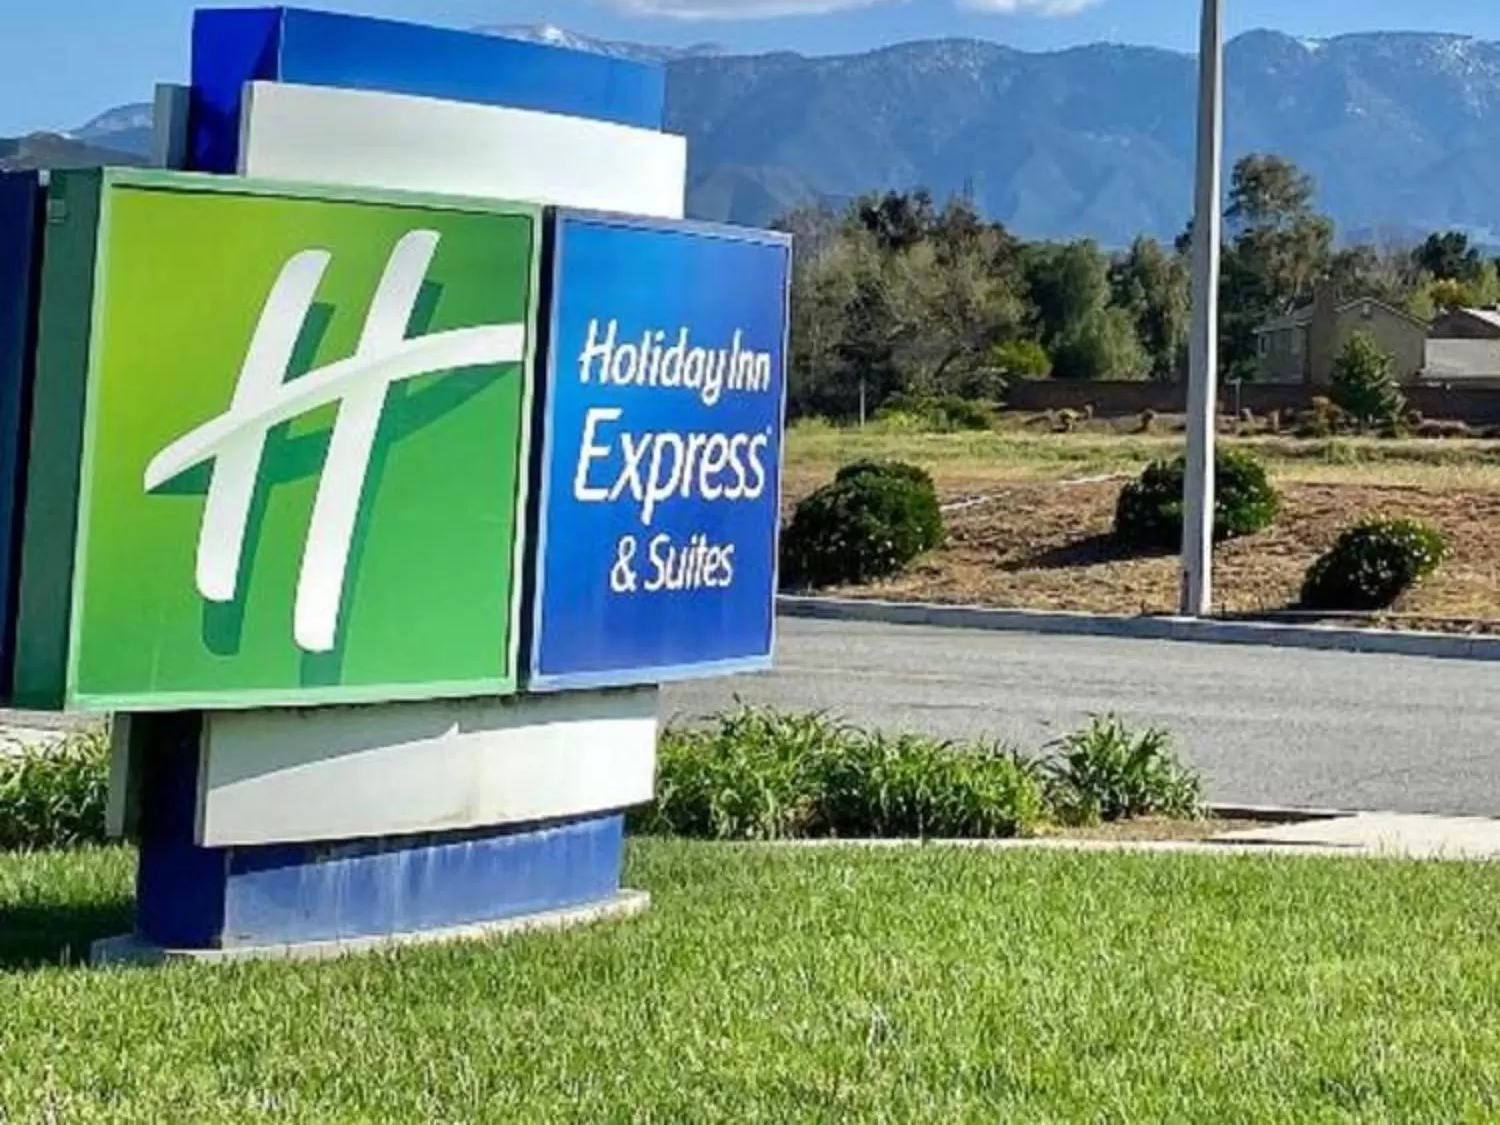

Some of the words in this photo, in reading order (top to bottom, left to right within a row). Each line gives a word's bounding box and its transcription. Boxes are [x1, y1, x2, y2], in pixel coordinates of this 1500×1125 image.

[573, 407, 769, 525] Express
[609, 535, 638, 592] &
[643, 532, 735, 592] Suites
